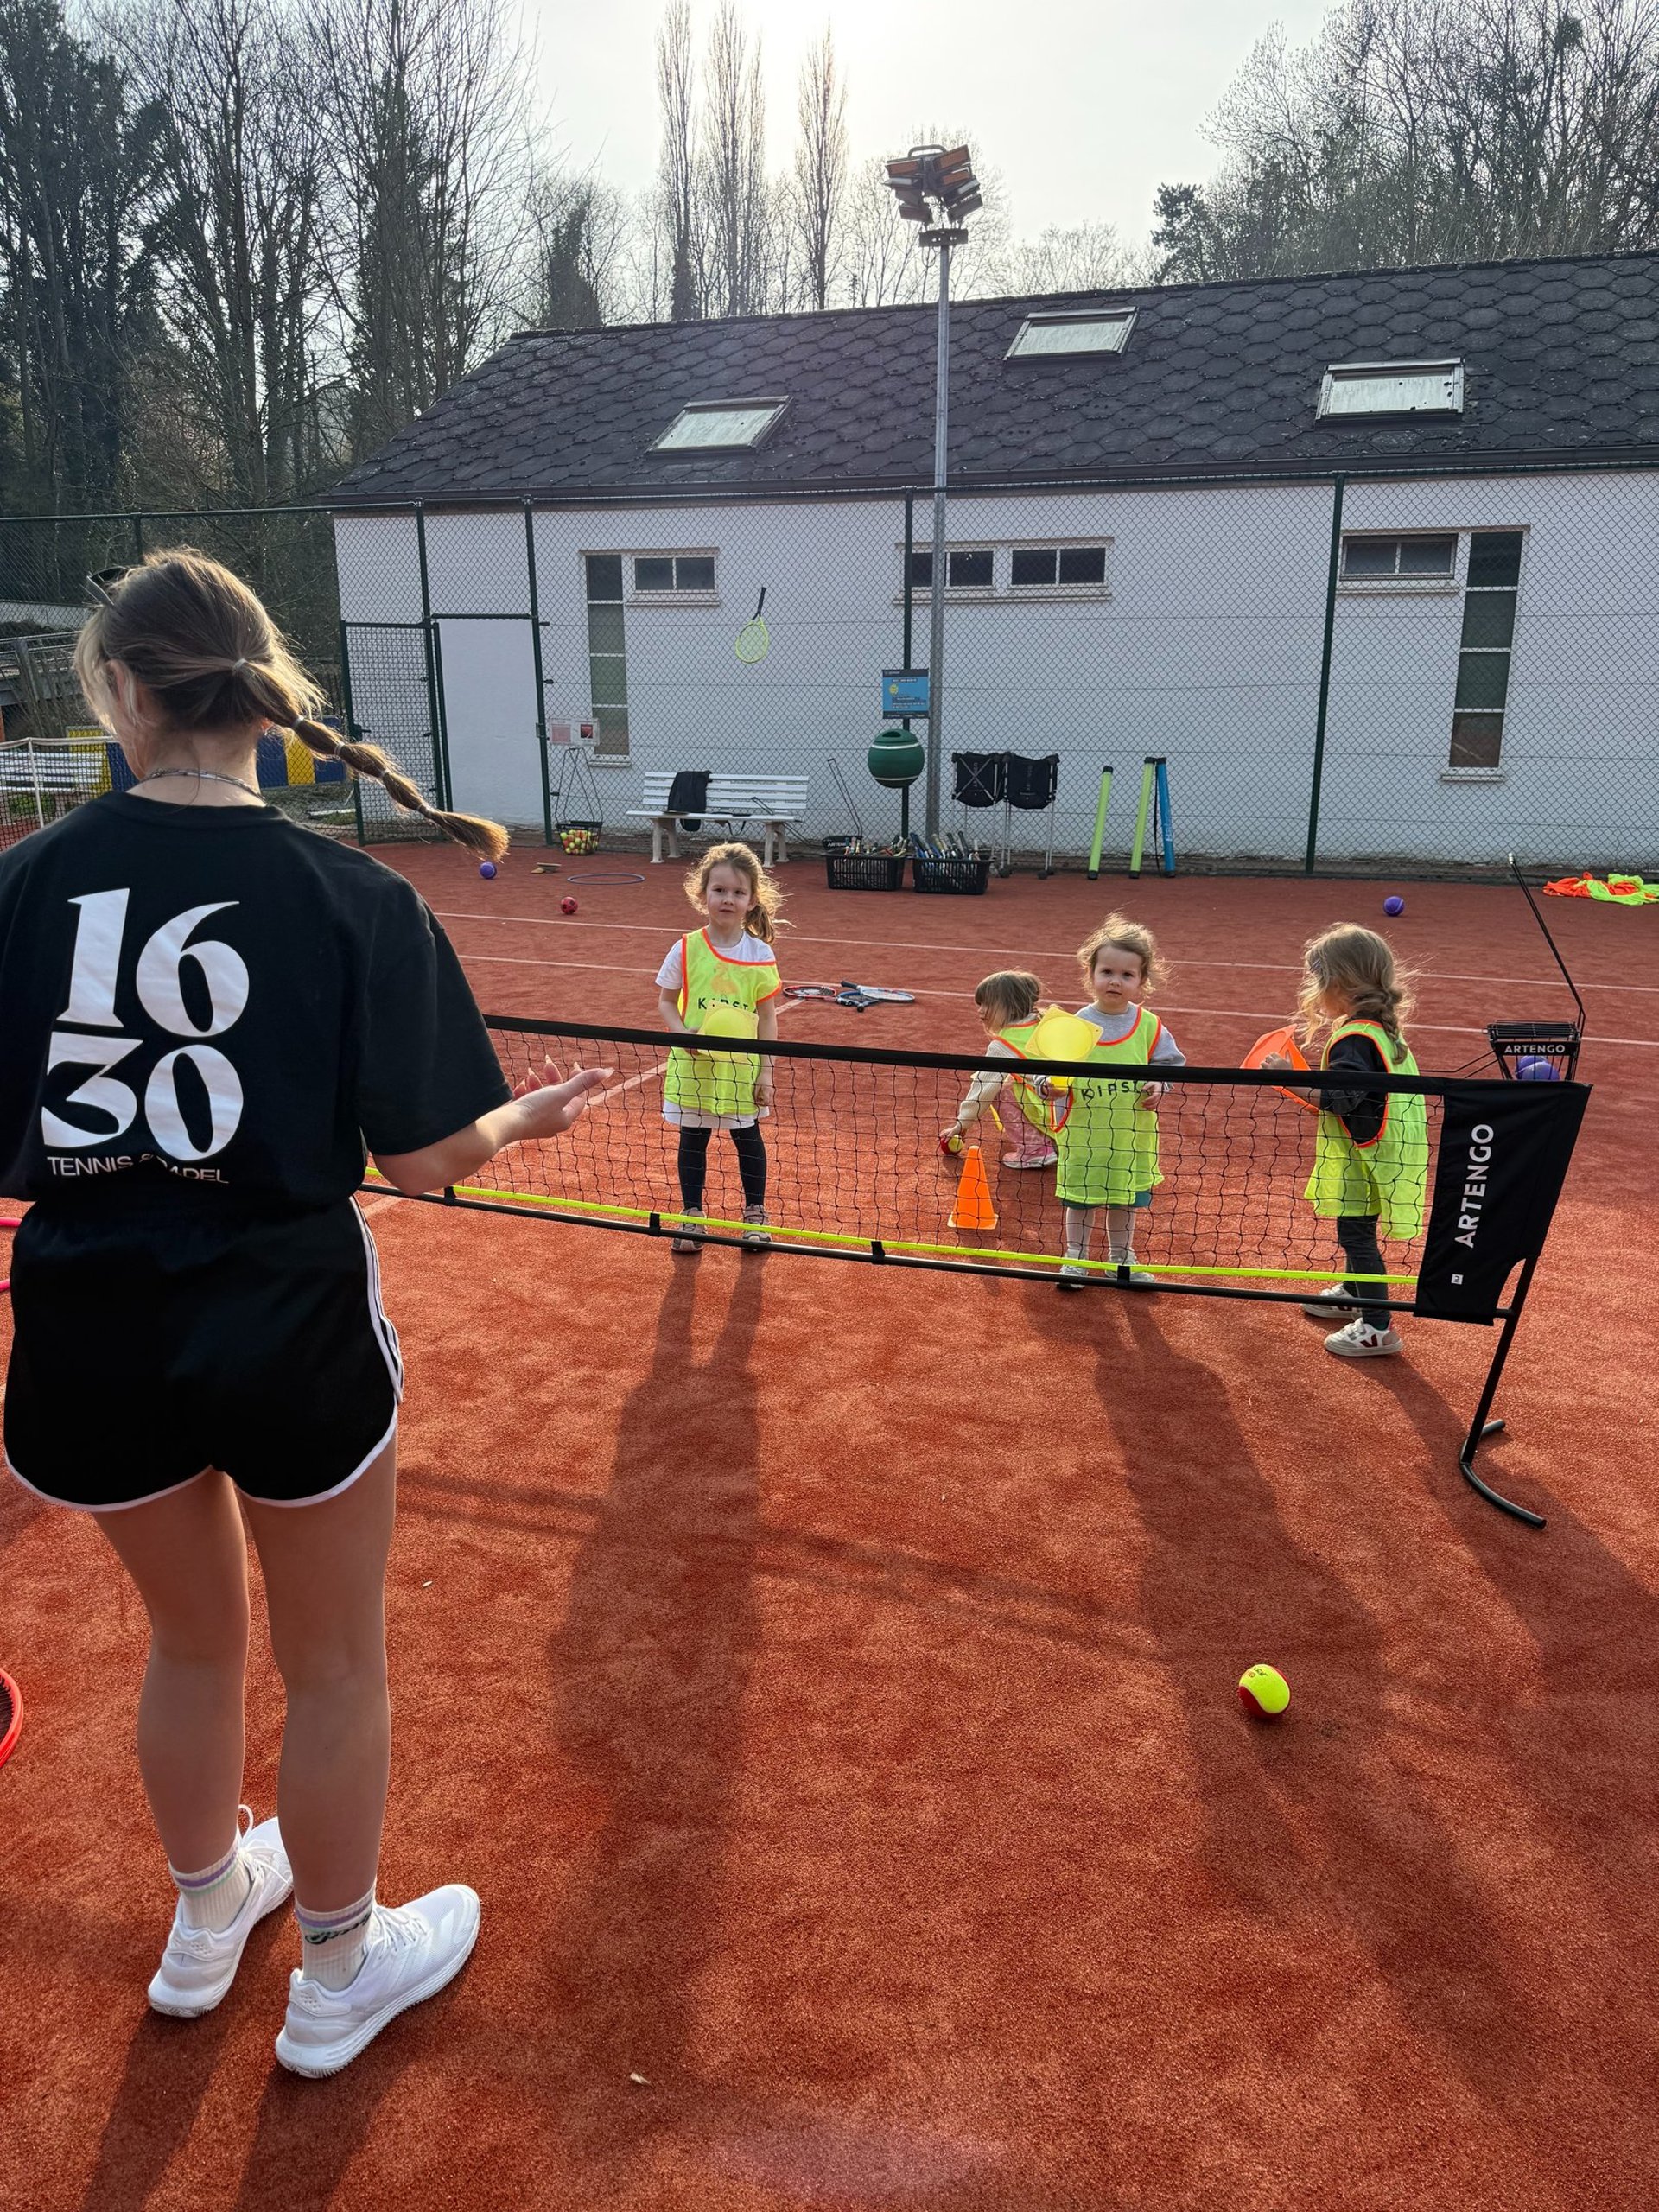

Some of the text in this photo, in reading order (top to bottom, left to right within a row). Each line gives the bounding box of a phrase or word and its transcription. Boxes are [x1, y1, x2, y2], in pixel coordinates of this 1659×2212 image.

[55, 887, 250, 1037] 16
[41, 1031, 244, 1161] 30
[1504, 1045, 1565, 1053] ARTENGO
[47, 1156, 134, 1176] TENNIS
[1454, 1123, 1495, 1249] ARTENGO
